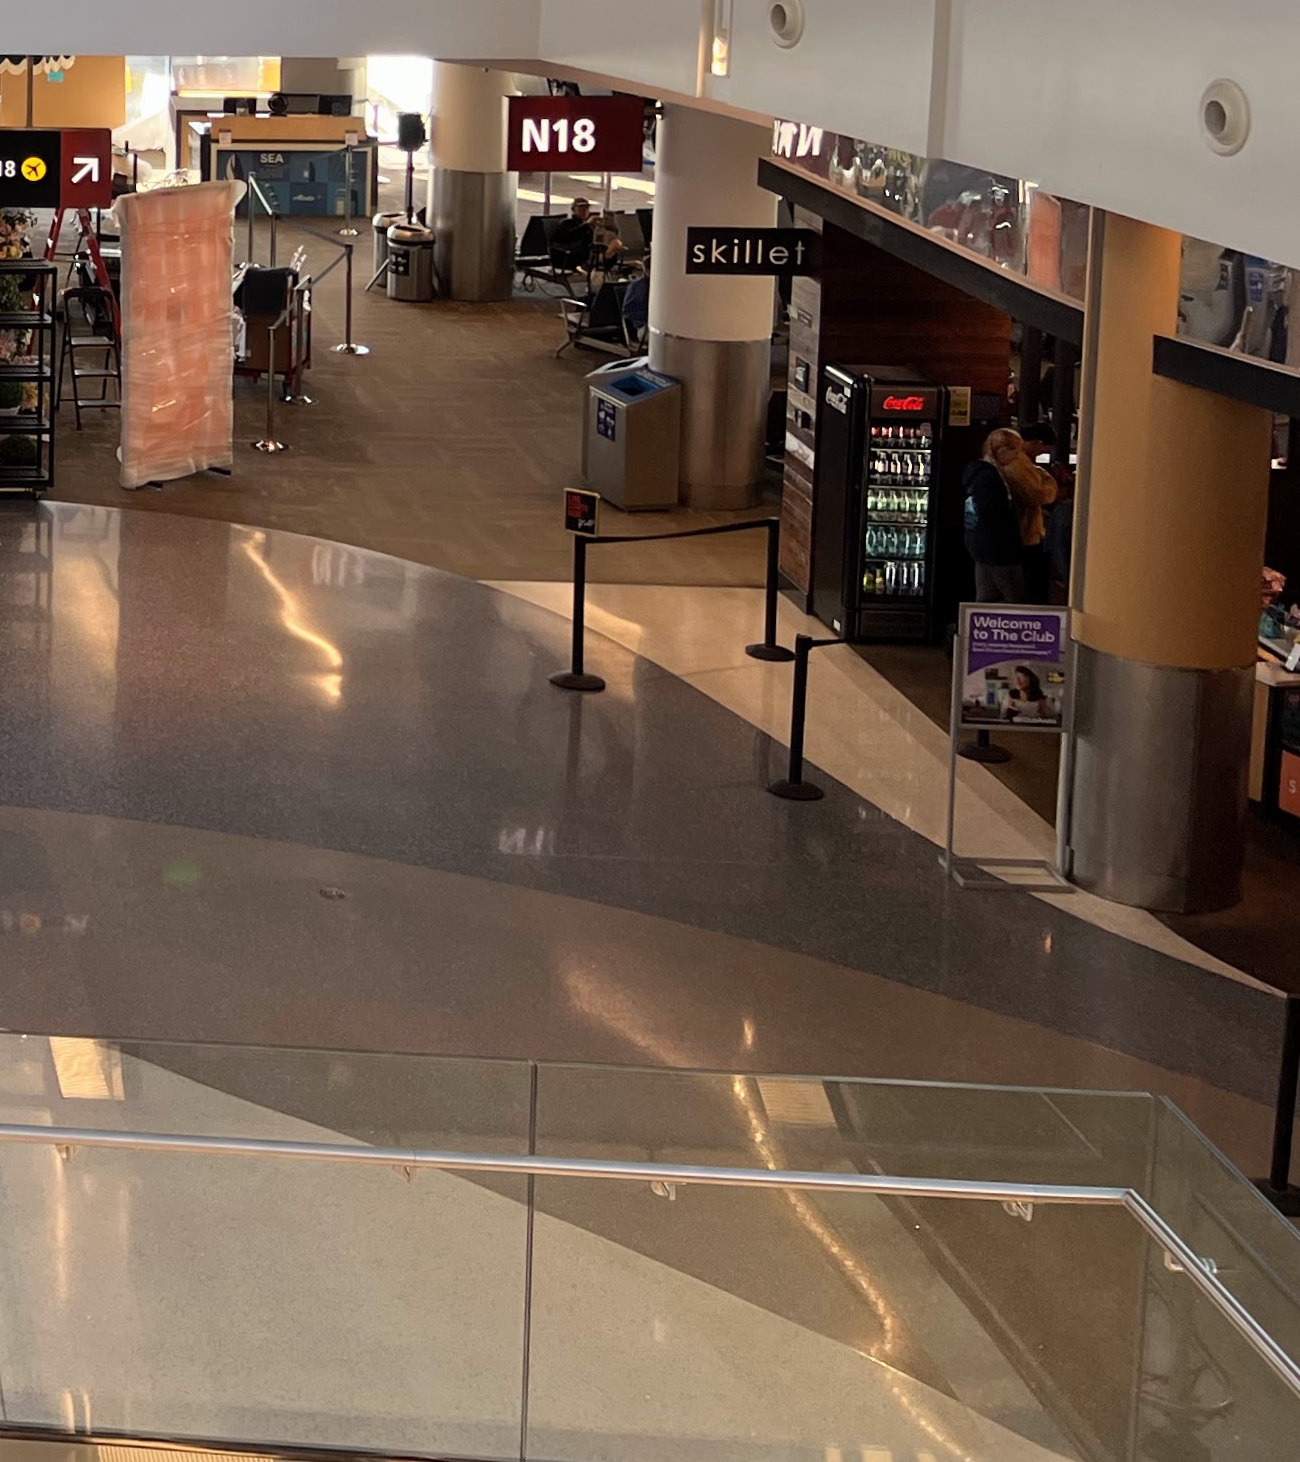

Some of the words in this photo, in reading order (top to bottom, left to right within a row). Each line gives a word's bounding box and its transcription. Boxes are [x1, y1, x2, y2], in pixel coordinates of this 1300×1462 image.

[521, 118, 596, 153] N18
[260, 153, 284, 164] SEA
[692, 238, 806, 265] skillet
[973, 616, 1042, 630] Welcome
[973, 629, 988, 640] to
[992, 630, 1018, 642] The
[1021, 631, 1056, 643] Club
